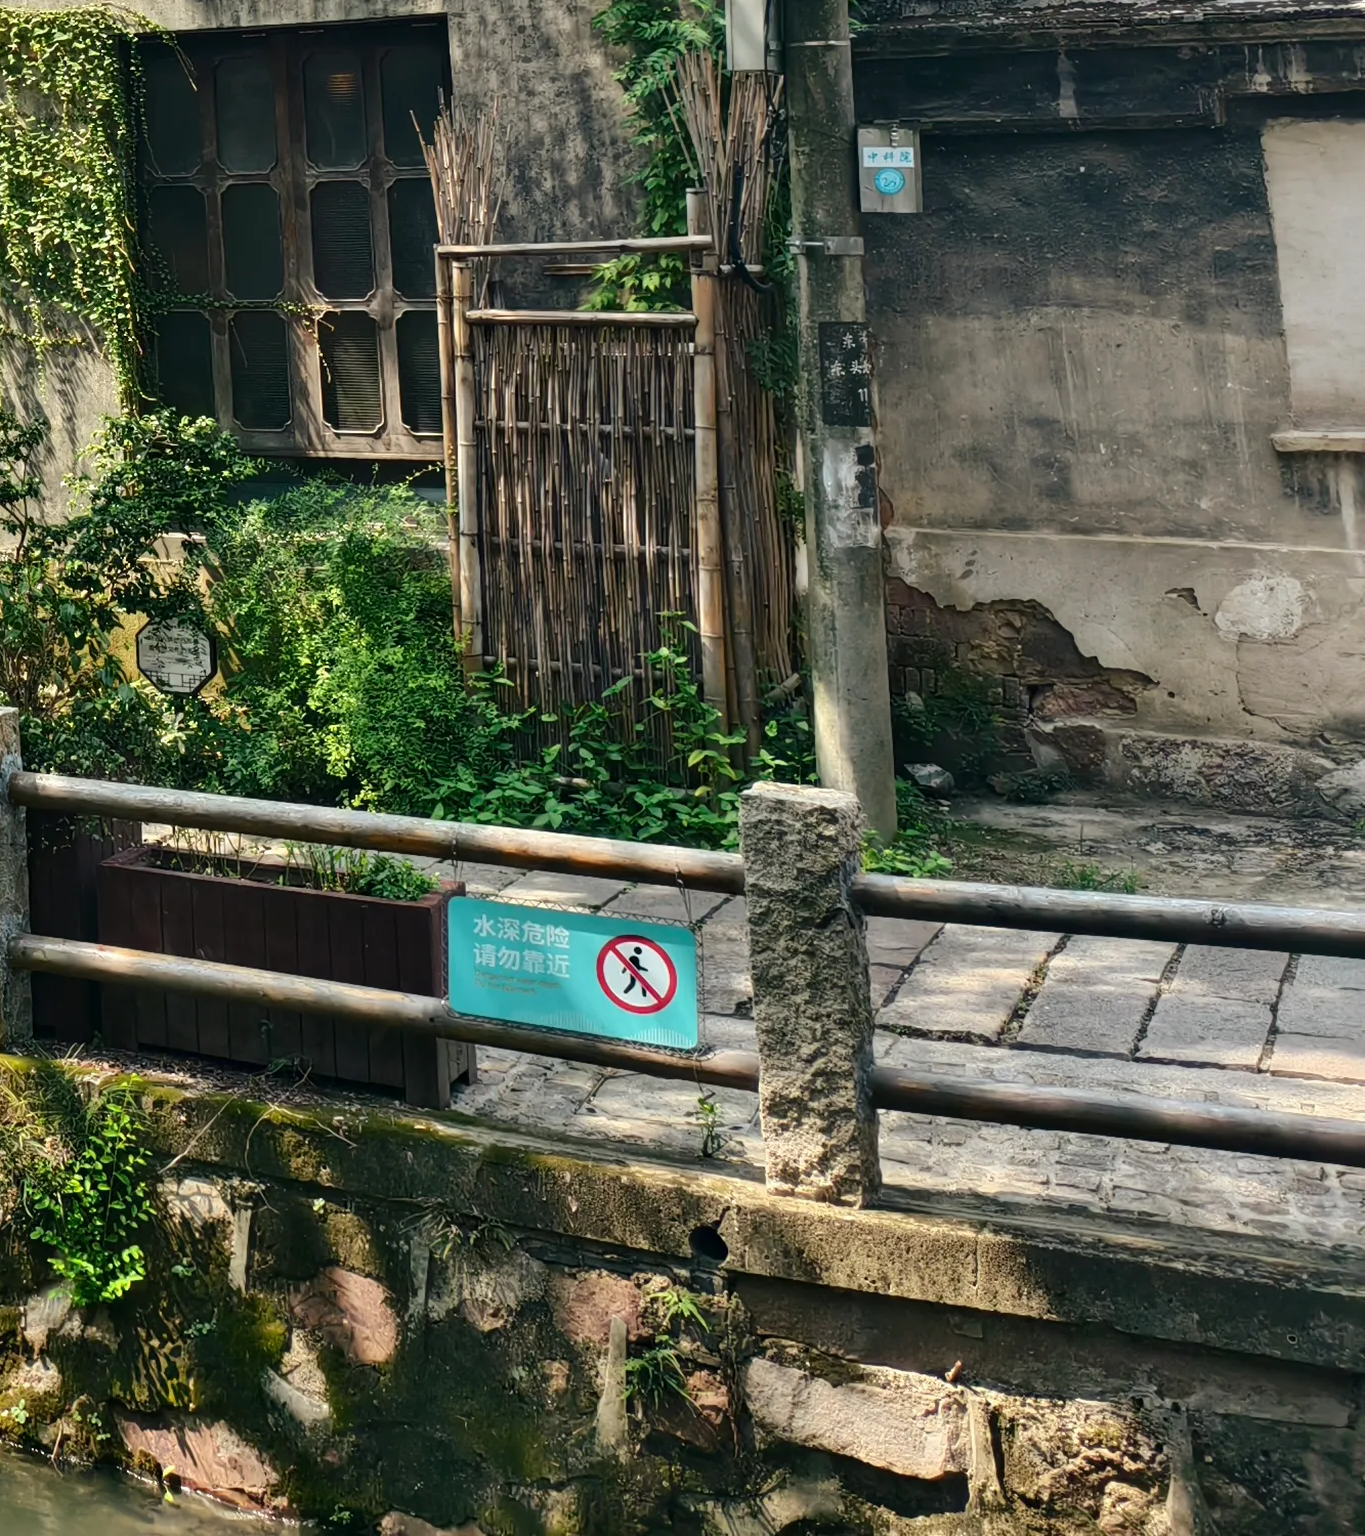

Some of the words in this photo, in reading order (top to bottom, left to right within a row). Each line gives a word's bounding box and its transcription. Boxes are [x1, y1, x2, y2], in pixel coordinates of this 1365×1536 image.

[473, 914, 570, 949] 水深危险
[473, 942, 570, 978] 请勿靠近
